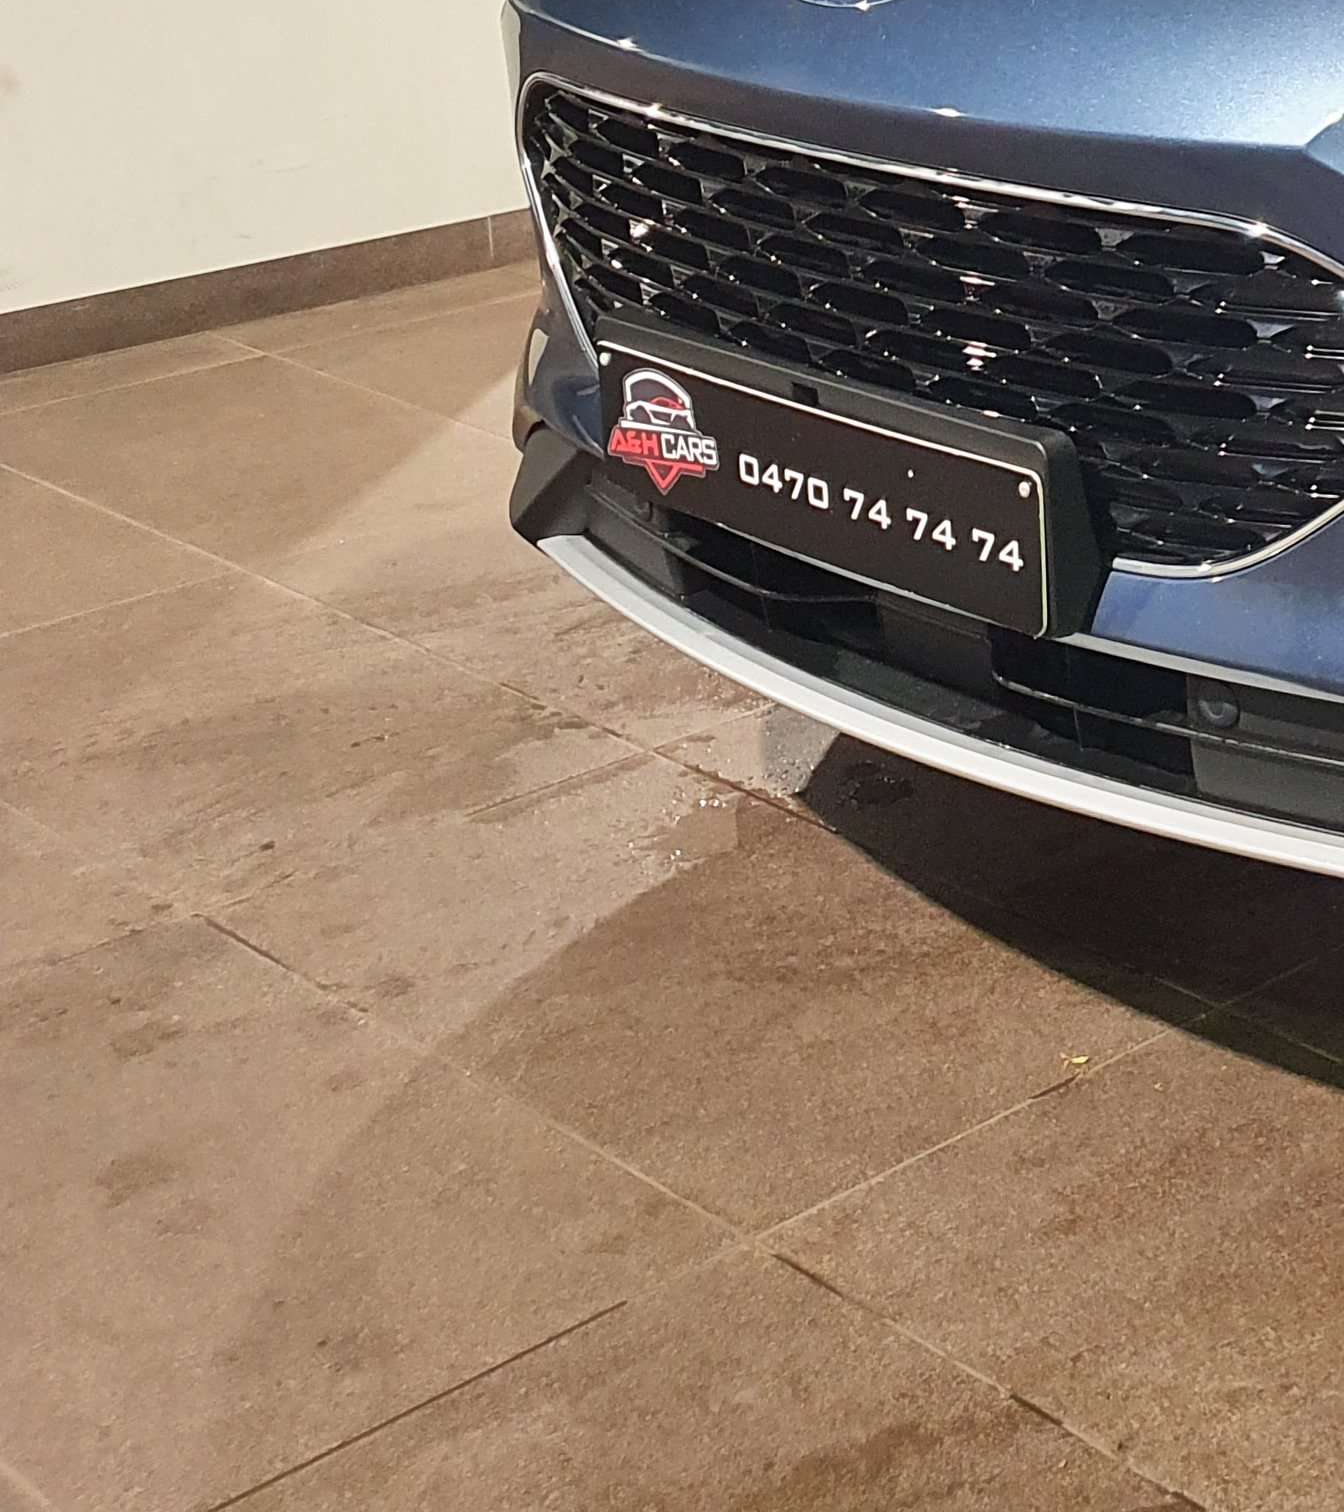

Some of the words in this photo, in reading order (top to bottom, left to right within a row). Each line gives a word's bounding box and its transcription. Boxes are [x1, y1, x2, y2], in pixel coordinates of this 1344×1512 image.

[610, 428, 659, 457] A&H
[660, 433, 718, 466] CARS
[739, 453, 829, 510] 0470
[843, 487, 892, 530] 74
[906, 507, 957, 551] 74
[972, 528, 1024, 572] 74
